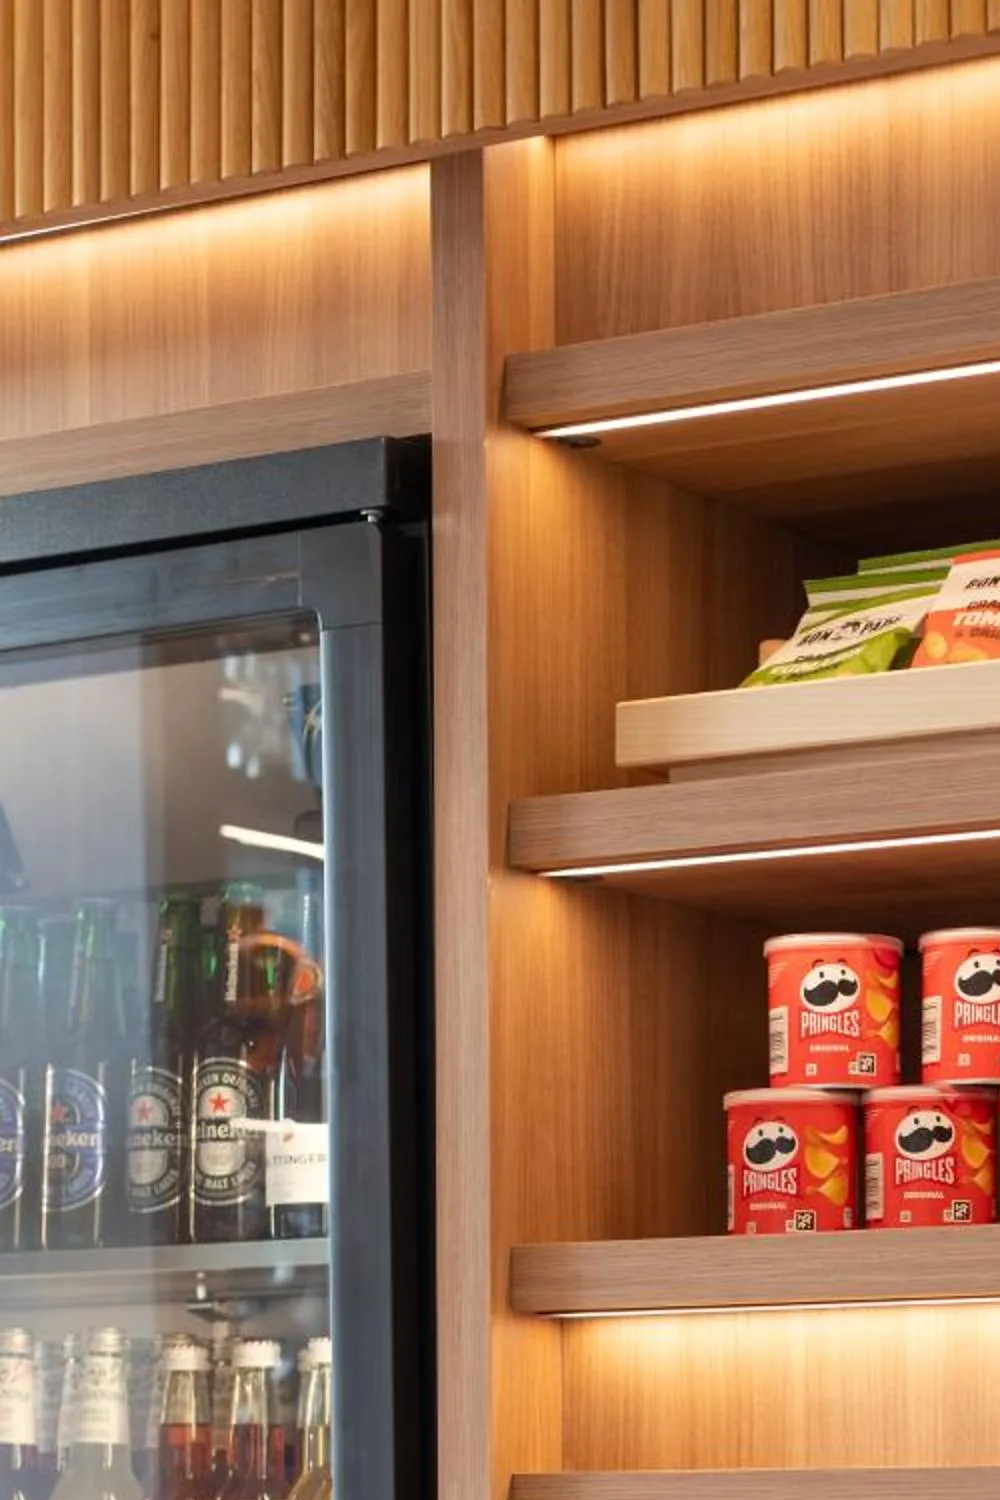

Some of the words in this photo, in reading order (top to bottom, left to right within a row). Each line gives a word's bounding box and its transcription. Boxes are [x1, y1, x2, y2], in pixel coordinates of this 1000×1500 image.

[801, 1009, 861, 1037] PRINGLES
[742, 1167, 798, 1196] PRINGLES
[895, 1156, 955, 1185] PRINGLES
